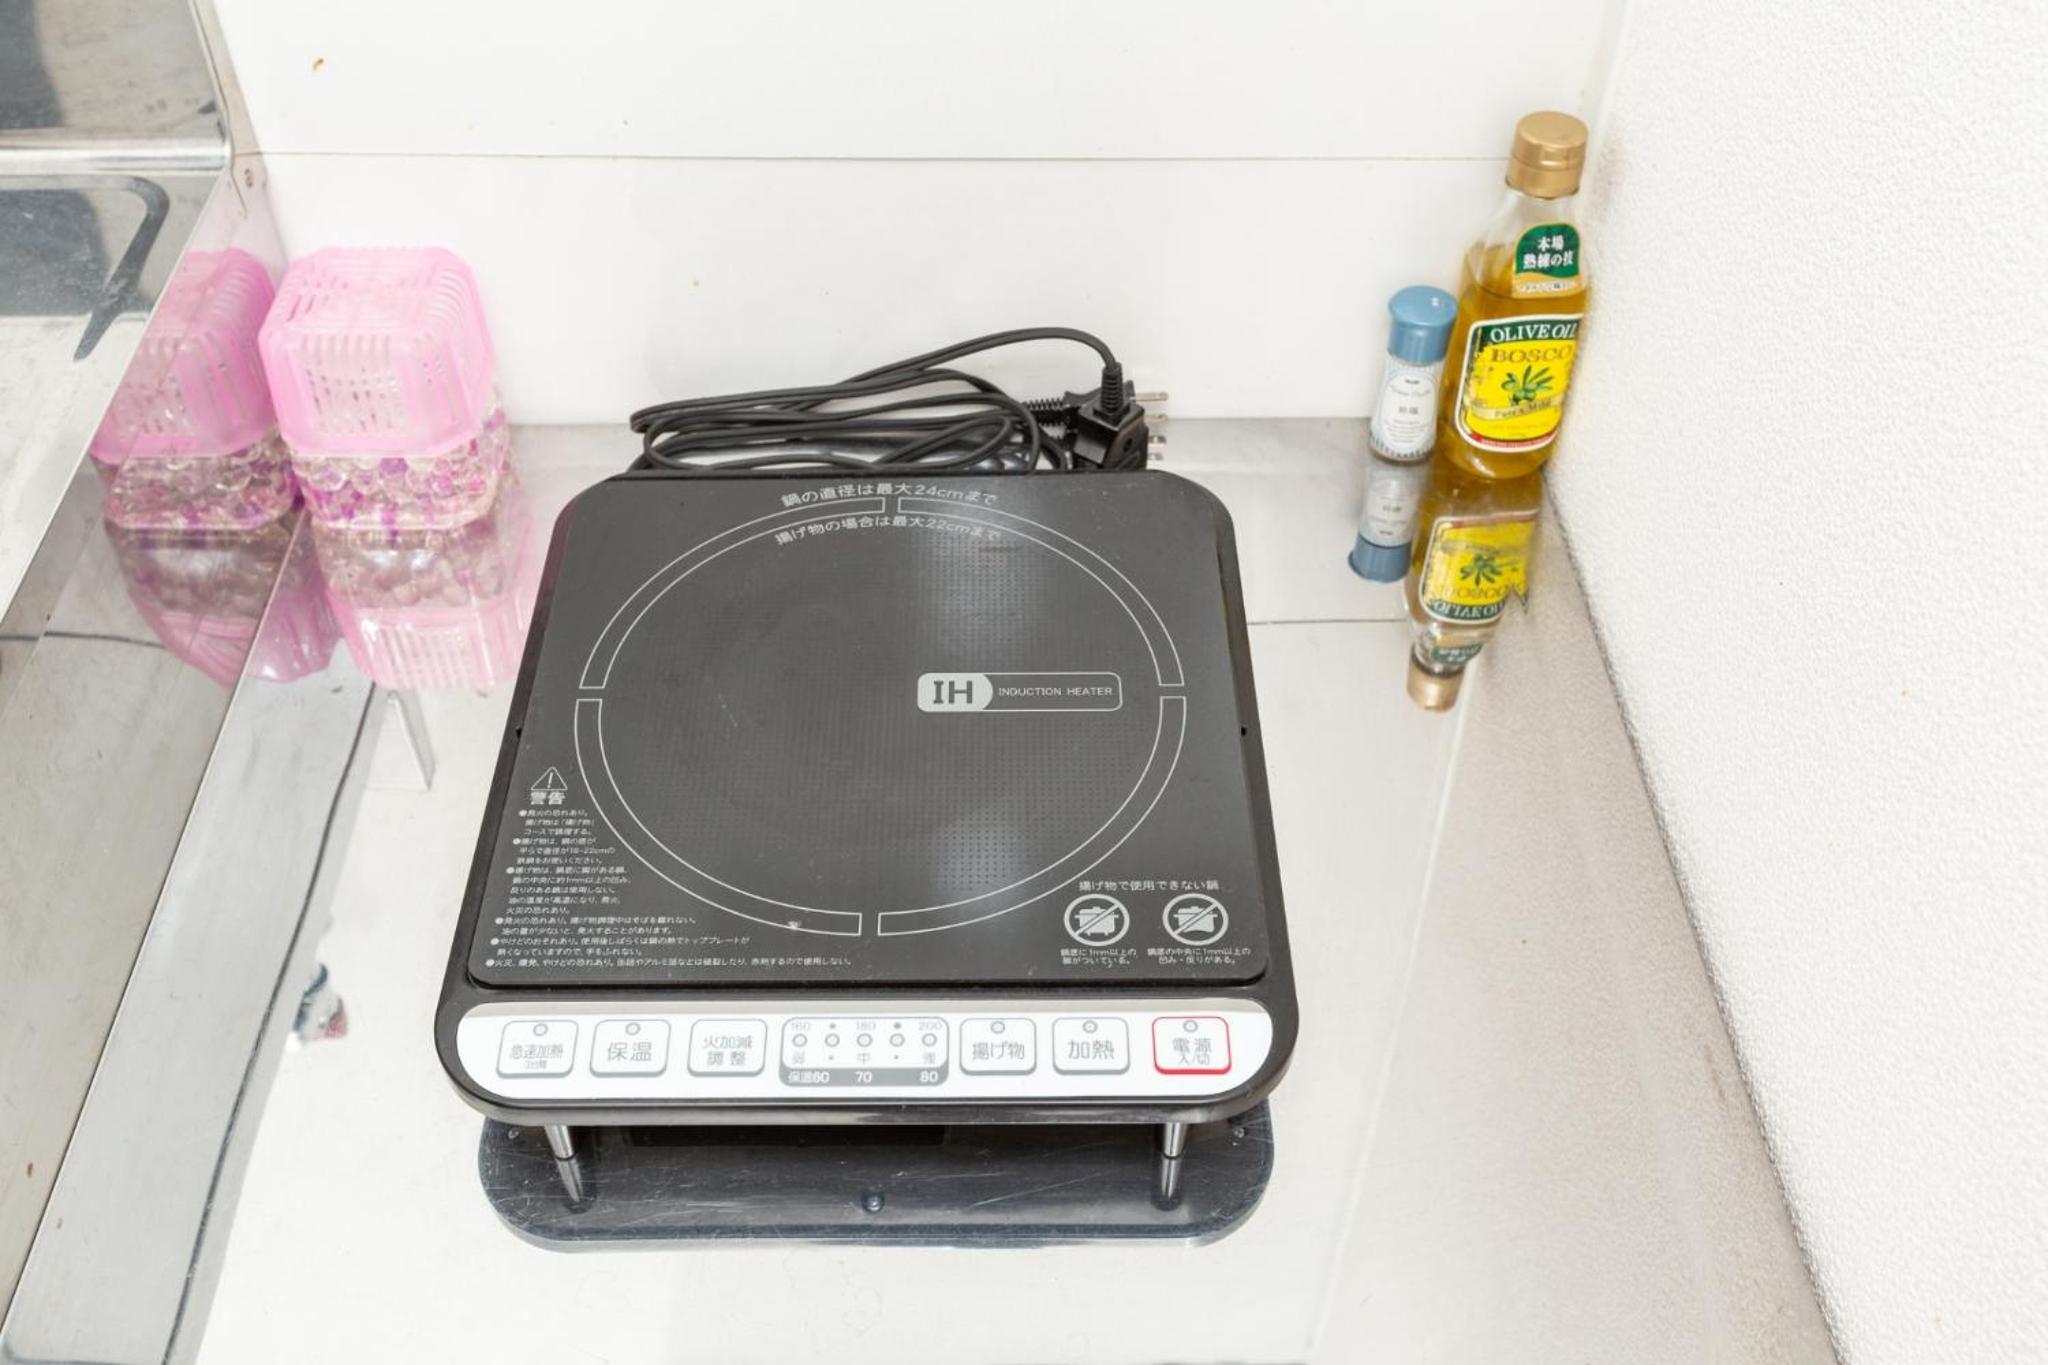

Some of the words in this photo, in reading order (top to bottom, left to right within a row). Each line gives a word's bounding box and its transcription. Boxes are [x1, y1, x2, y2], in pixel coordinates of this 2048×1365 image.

[1537, 235, 1564, 252] 本場
[1522, 250, 1574, 270] 熟練の技
[1490, 323, 1551, 344] OLIVE
[1491, 346, 1573, 363] BOSCO
[781, 483, 997, 507] 鍋の直径は最大24cmまで
[775, 516, 1001, 545] 揚げ物の場合は最大22cmまで
[933, 680, 973, 705] IH
[998, 687, 1062, 697] INDUCTION
[1066, 687, 1112, 697] HEATER
[1079, 880, 1220, 891] 揚げ物で使用できない鍋
[607, 1041, 653, 1063] 保温
[703, 1035, 753, 1050] 火加減
[972, 1040, 1025, 1061] 揚げ物
[1067, 1039, 1115, 1061] 加熱
[1172, 1037, 1213, 1053] 電源
[707, 1051, 746, 1067] 調整
[855, 1071, 873, 1083] 70
[919, 1070, 938, 1083] 80
